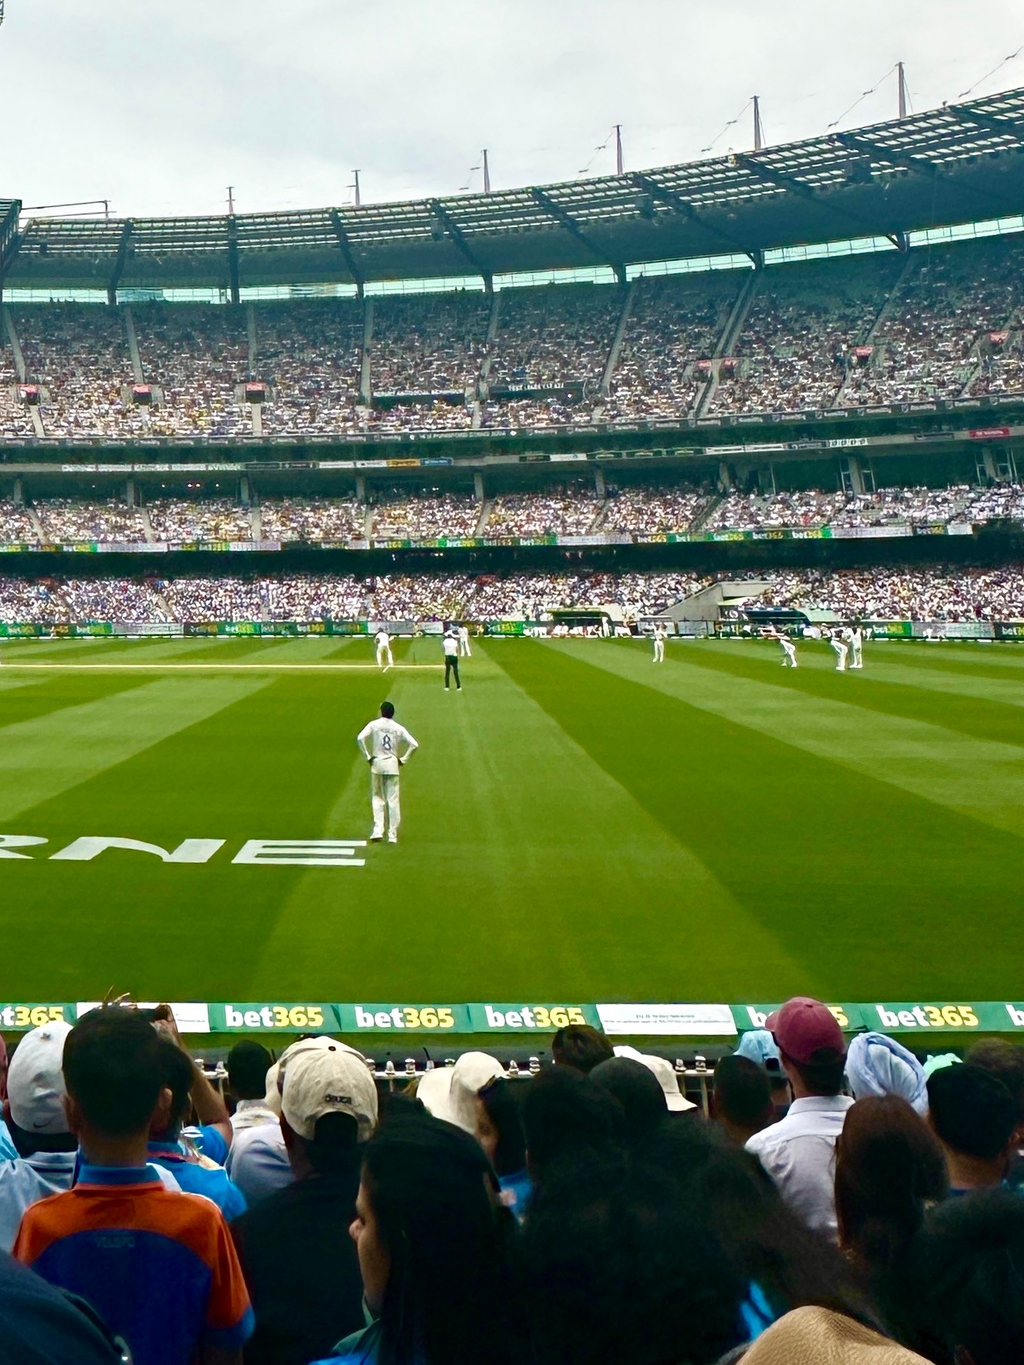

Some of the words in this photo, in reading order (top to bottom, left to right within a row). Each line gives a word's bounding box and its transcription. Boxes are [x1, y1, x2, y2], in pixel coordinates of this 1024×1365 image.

[382, 733, 391, 751] 8
[225, 1005, 323, 1028] bet365
[355, 1006, 454, 1028] bet365
[484, 1005, 586, 1028] bet365
[876, 1005, 979, 1027] bet365
